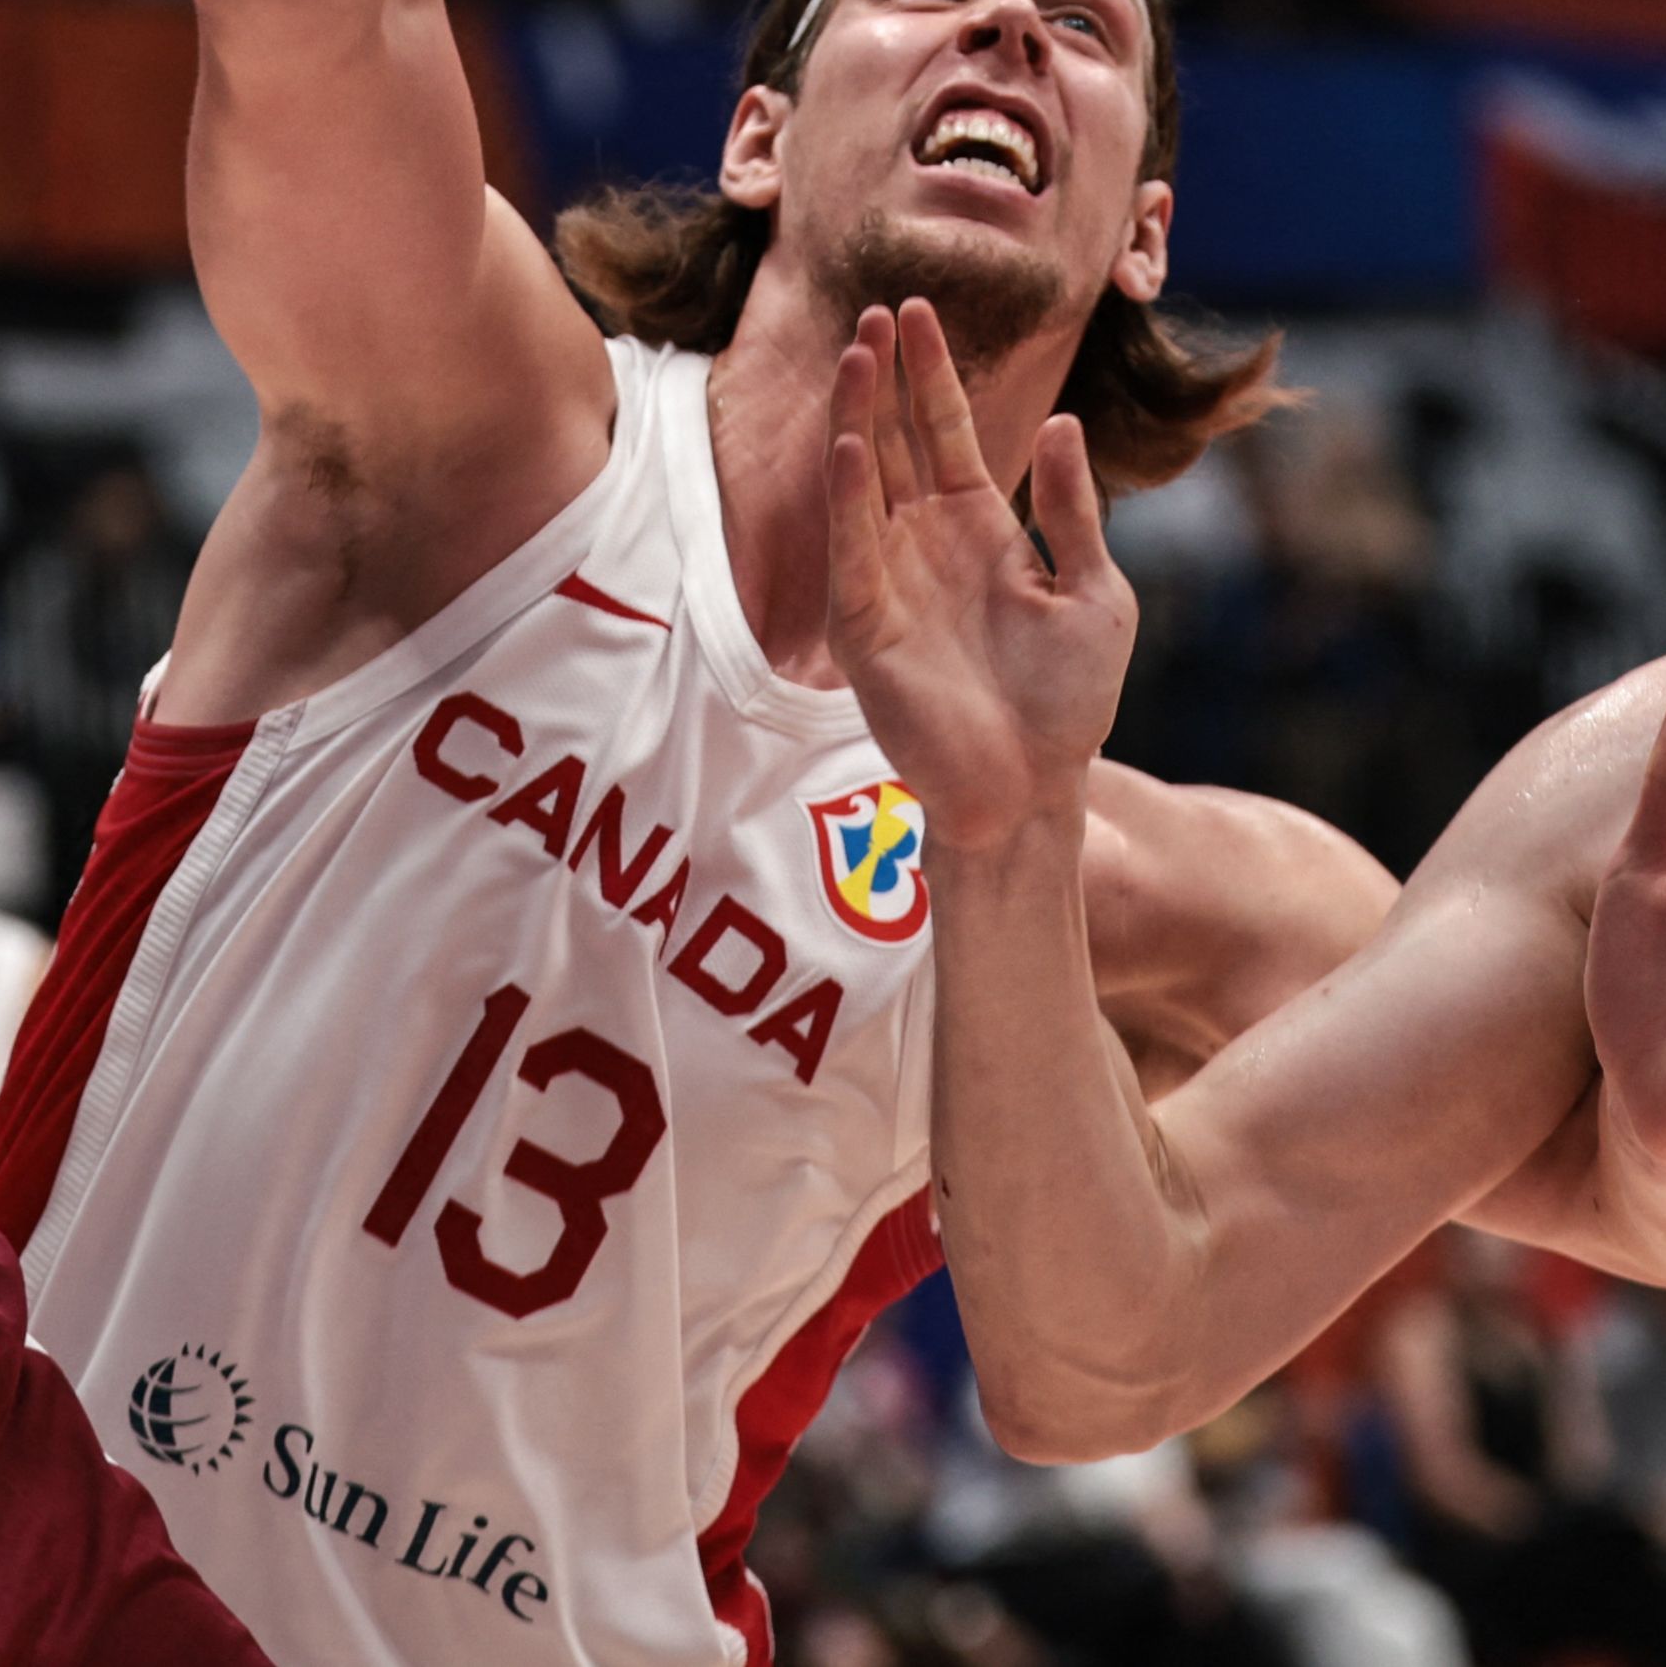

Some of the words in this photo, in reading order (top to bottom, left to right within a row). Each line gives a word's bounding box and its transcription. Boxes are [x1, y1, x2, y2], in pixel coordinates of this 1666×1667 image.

[412, 690, 844, 1086] CANADA
[361, 982, 668, 1320] 13
[263, 1423, 389, 1549] Sun
[395, 1500, 549, 1623] Life
